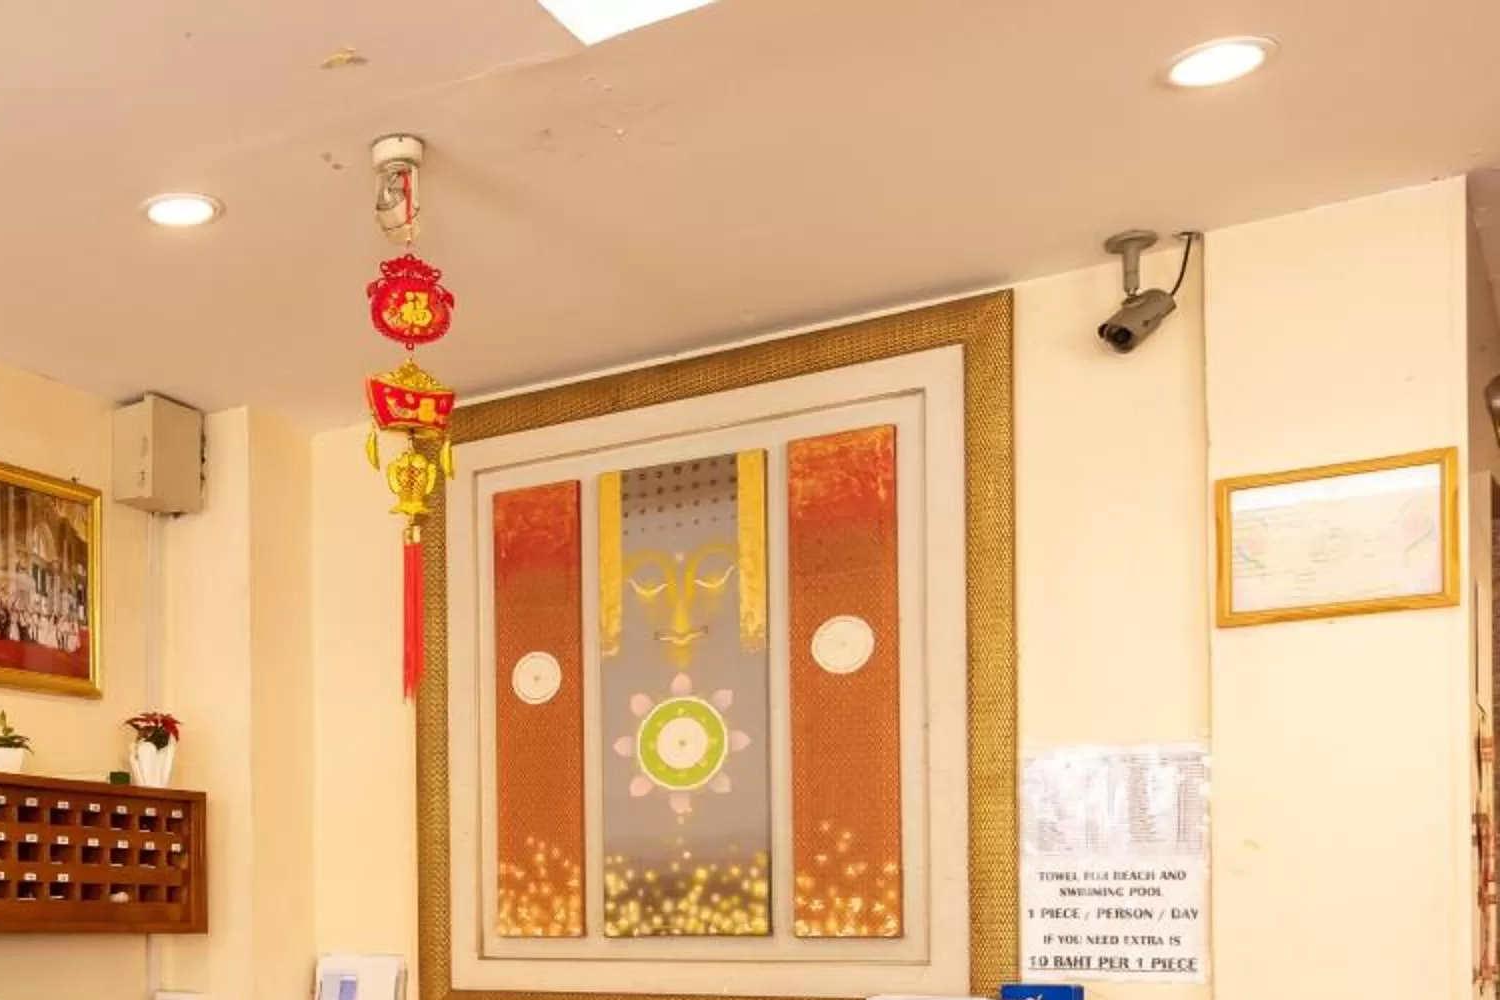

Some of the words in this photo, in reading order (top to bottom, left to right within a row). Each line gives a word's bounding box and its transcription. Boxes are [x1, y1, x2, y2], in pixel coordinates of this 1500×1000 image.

[1039, 871, 1078, 881] TOWEL
[1113, 871, 1155, 881] BEACH
[1160, 870, 1187, 881] AND
[1129, 887, 1163, 897] POOL
[1027, 908, 1035, 919] 1
[1041, 908, 1081, 919] PIECE
[1097, 908, 1153, 919] PERSON
[1171, 908, 1199, 920] DAY
[1043, 935, 1055, 945] IF
[1058, 935, 1082, 945] YOU
[1087, 936, 1119, 946] NEED
[1124, 935, 1164, 946] EXTRA
[1169, 936, 1181, 946] IS
[1054, 955, 1092, 968] BAHT
[1099, 955, 1129, 969] PER
[1151, 957, 1198, 971] PIECE
